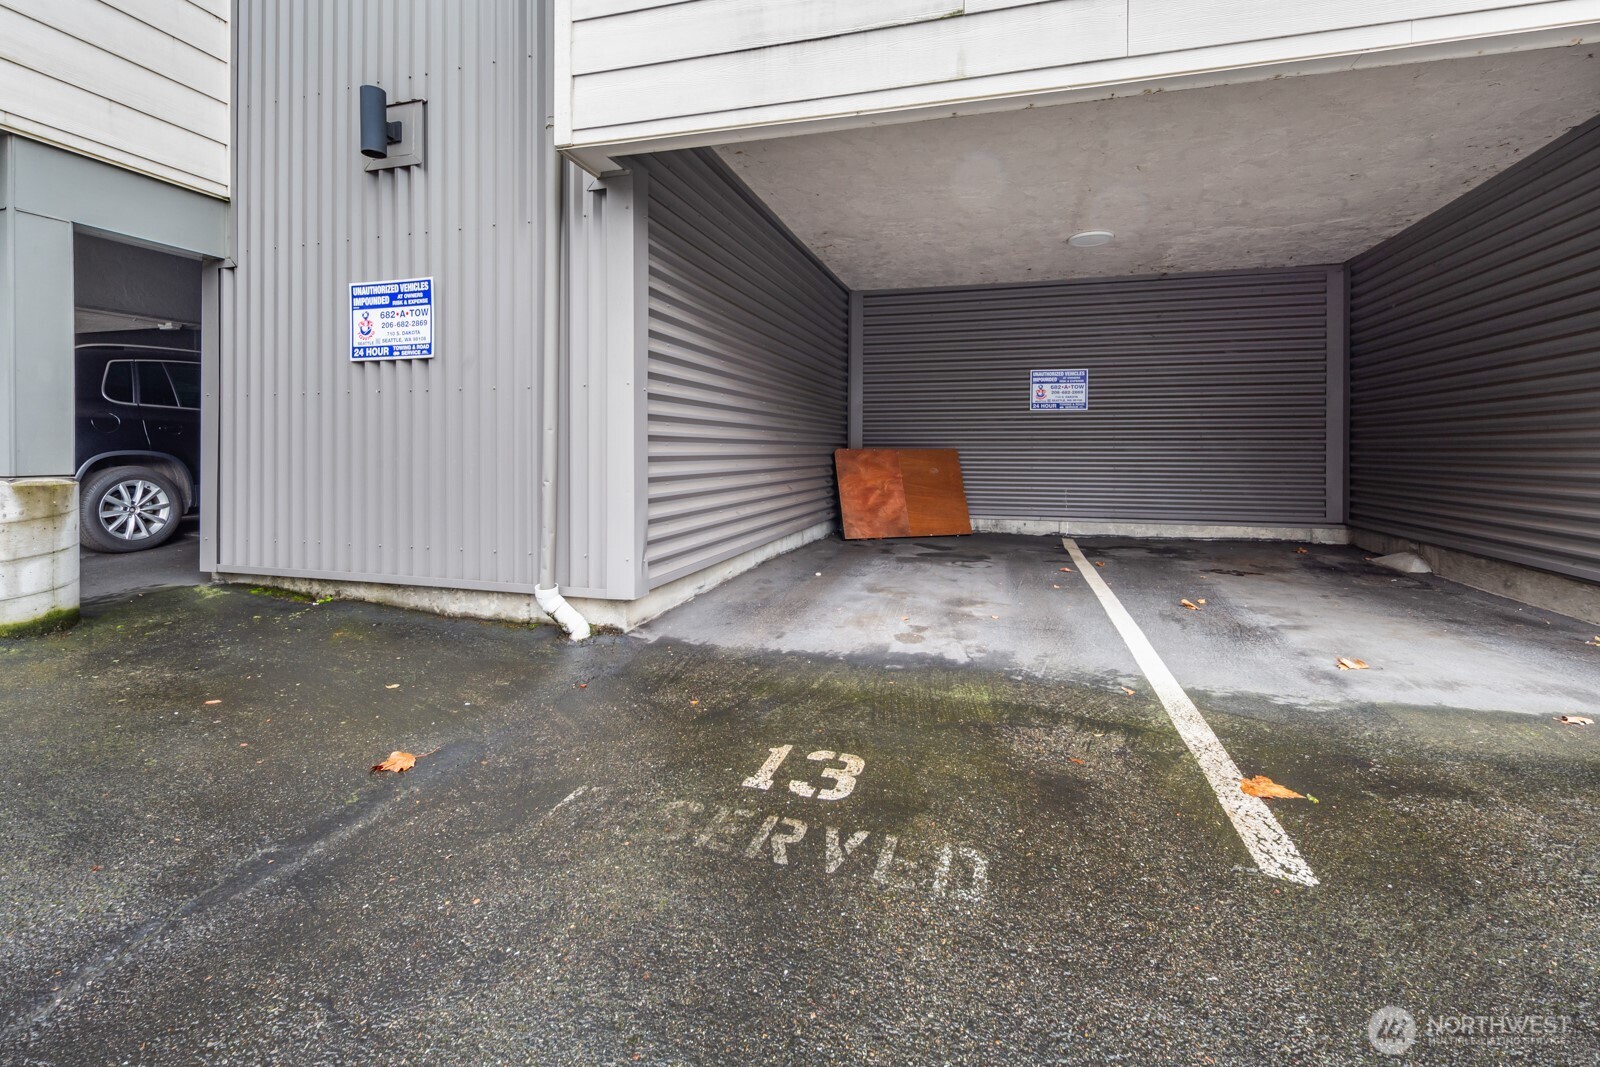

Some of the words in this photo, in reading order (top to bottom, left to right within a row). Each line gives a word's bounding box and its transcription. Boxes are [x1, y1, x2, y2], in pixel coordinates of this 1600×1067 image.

[353, 284, 399, 296] UNAUTHORIZED
[399, 281, 429, 293] VEHICLES
[353, 295, 390, 307] IMPOUNDED
[381, 319, 428, 329] 206-682-2869
[353, 348, 364, 357] 24
[366, 346, 390, 356] HOUR
[742, 744, 867, 800] 13
